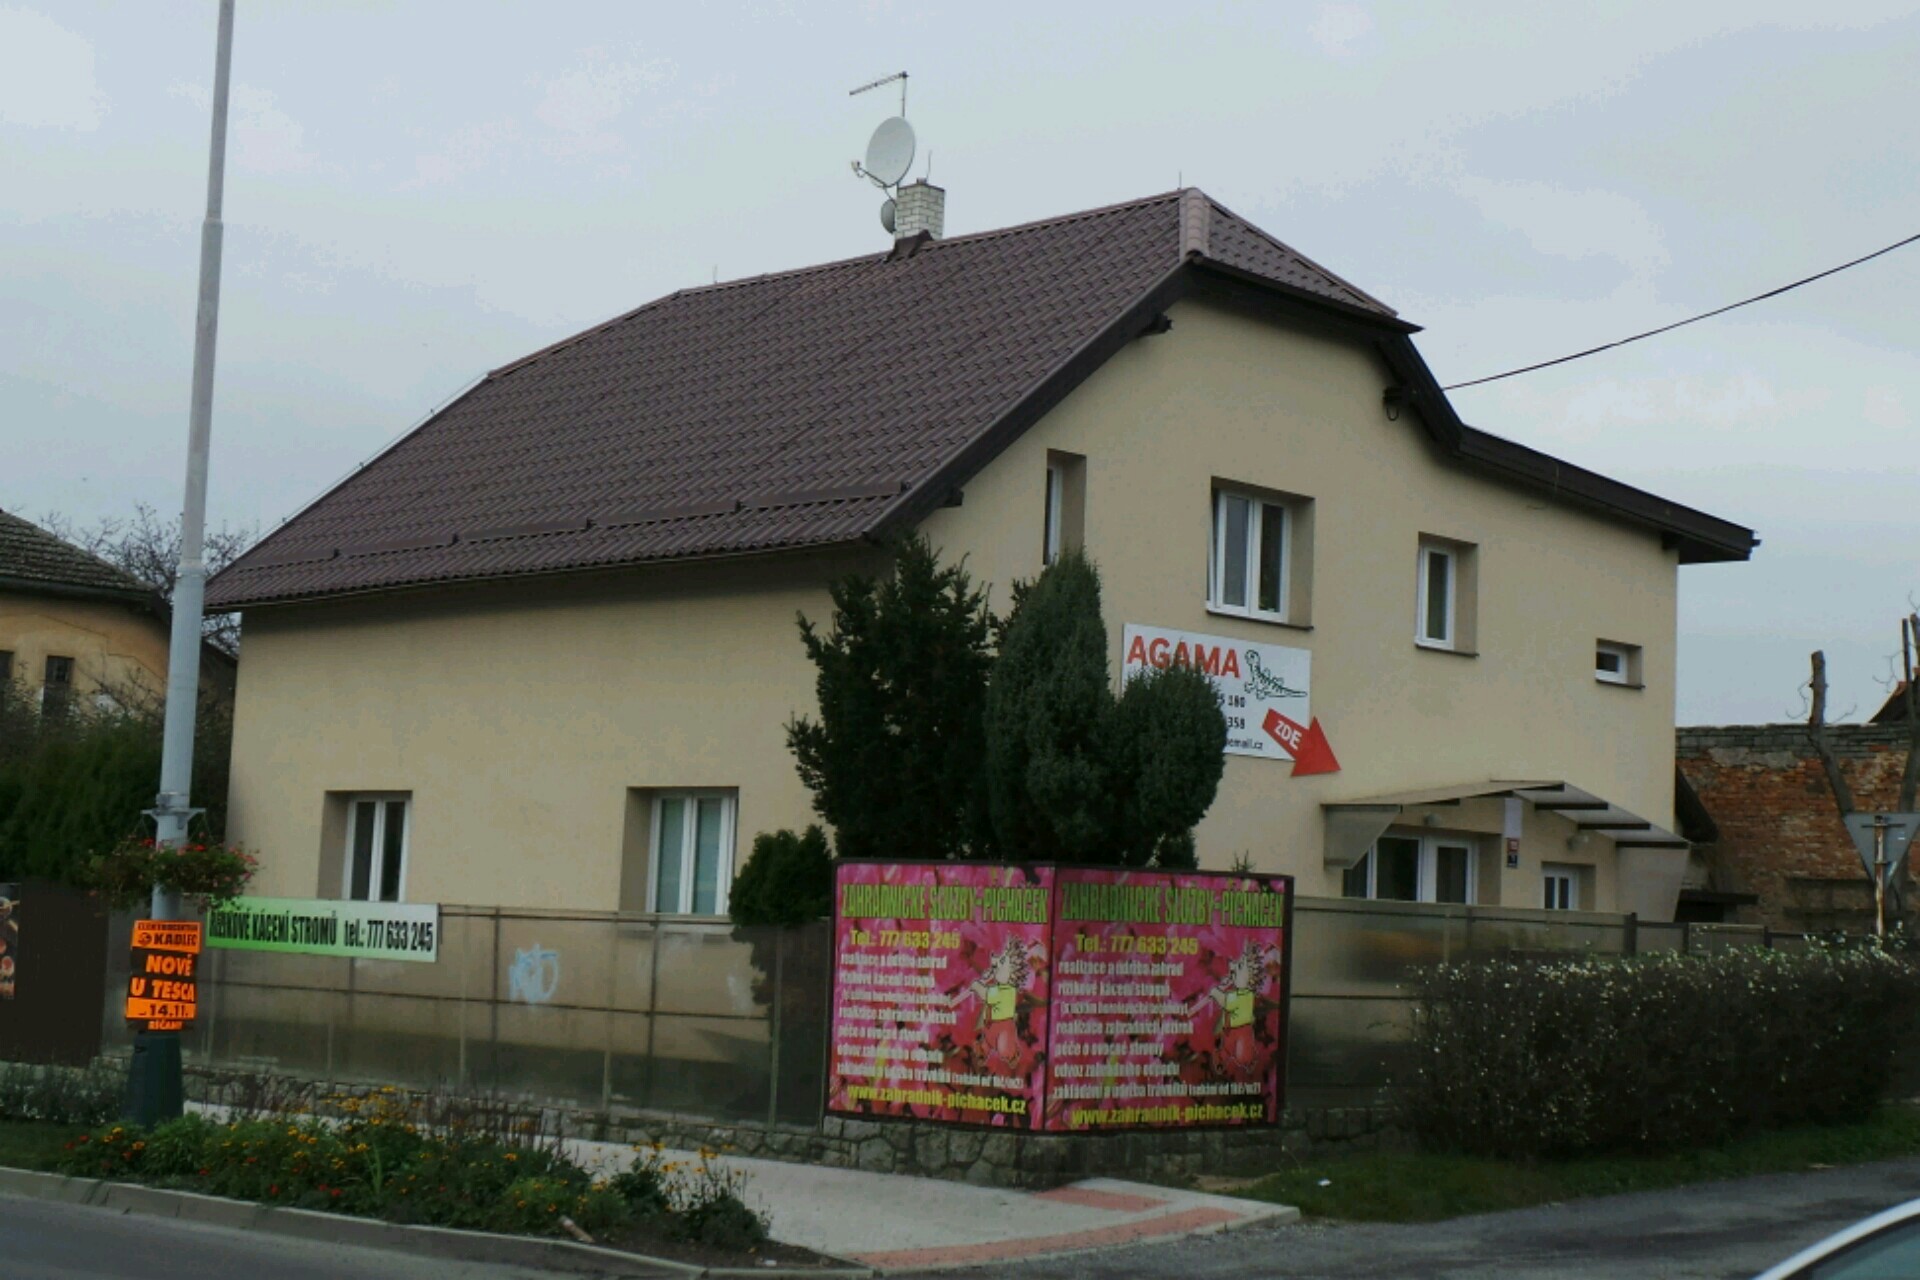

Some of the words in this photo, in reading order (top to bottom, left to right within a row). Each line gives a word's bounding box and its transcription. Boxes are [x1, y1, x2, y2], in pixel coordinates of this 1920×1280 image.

[1127, 635, 1241, 679] AGAMA
[1274, 719, 1303, 752] ZDE
[252, 908, 289, 944] KÁCENÍ
[290, 910, 337, 945] STROMŮ
[367, 919, 384, 949] 777
[387, 920, 409, 951] 633
[411, 921, 434, 953] 245
[880, 930, 902, 947] 777
[904, 931, 930, 949] 633
[931, 932, 961, 950] 245
[1075, 933, 1107, 953] Tel.:
[1110, 935, 1135, 953] 777
[1136, 936, 1167, 955] 633
[1169, 937, 1199, 955] 245
[145, 953, 193, 976] NOVÉ
[130, 976, 146, 997] U
[152, 978, 195, 1002] TESCA
